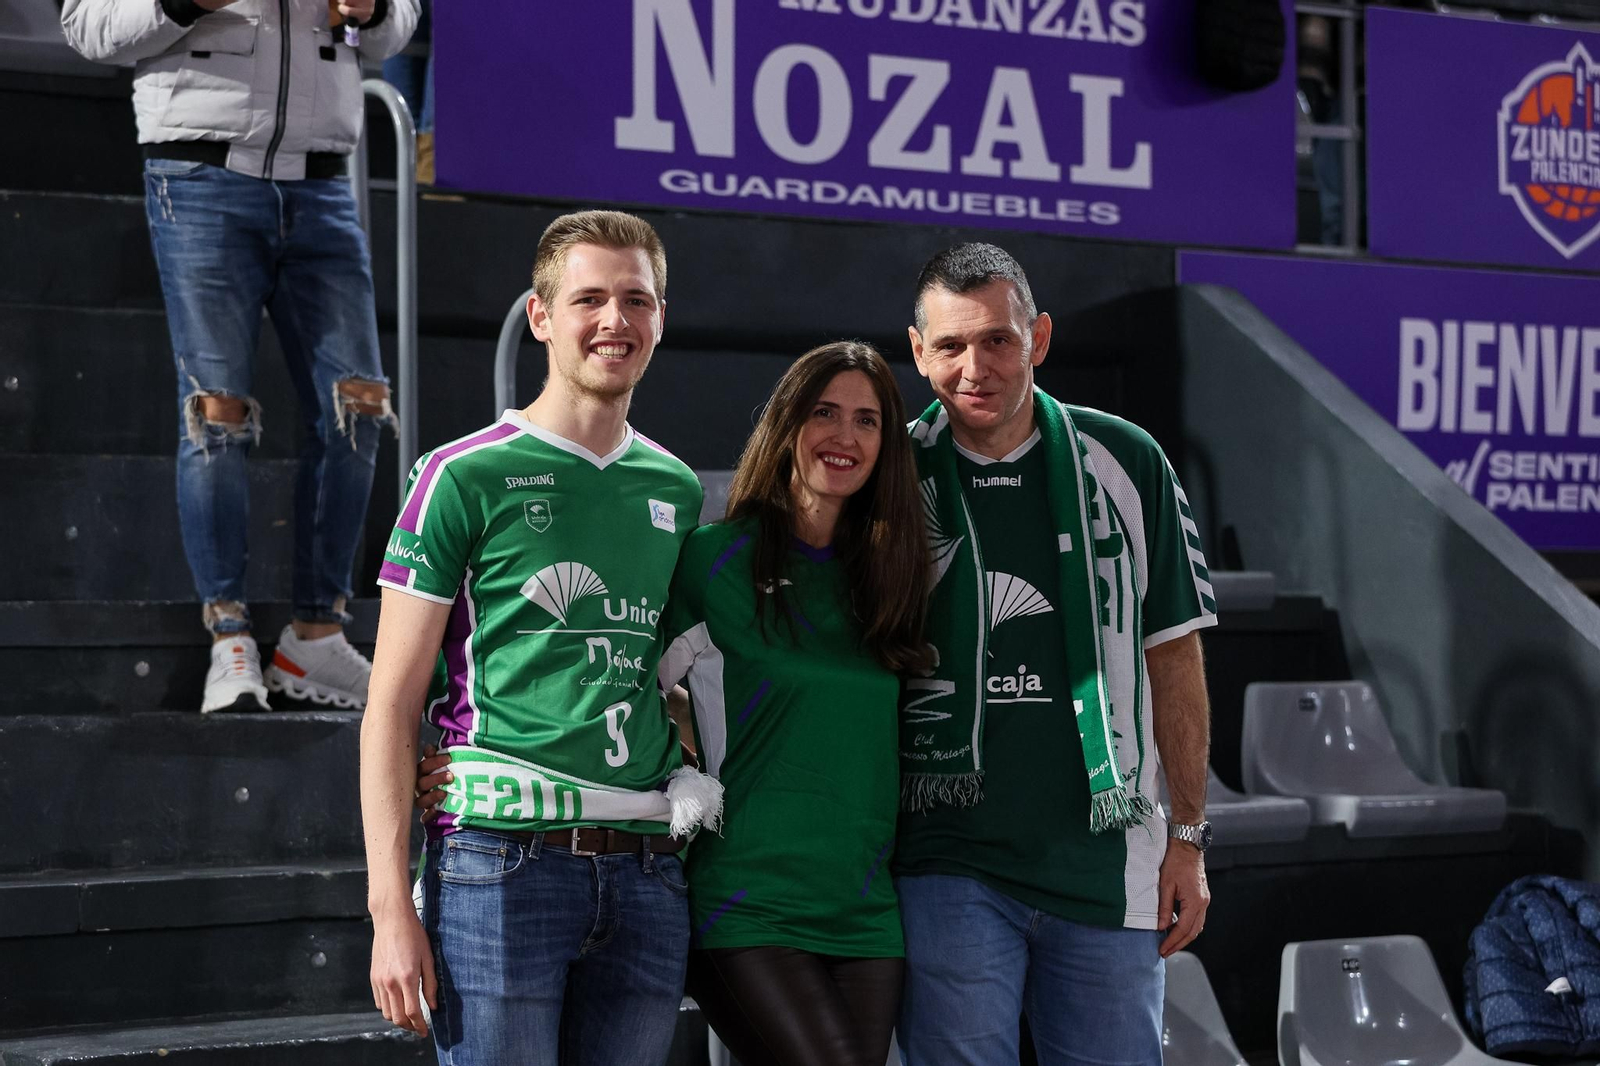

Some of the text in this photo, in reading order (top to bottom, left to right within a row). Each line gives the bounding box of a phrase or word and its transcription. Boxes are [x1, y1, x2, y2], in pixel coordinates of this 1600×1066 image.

[778, 0, 1147, 47] DANZAS
[615, 0, 1153, 189] NOZAL
[1510, 124, 1600, 164] ZUNDE
[659, 168, 1121, 226] GUARDAMUEBLES
[1397, 317, 1600, 438] BIENVE
[504, 472, 555, 490] SPALDING
[972, 474, 1022, 488] hummel
[385, 532, 434, 570] alucía
[986, 663, 1043, 698] caja
